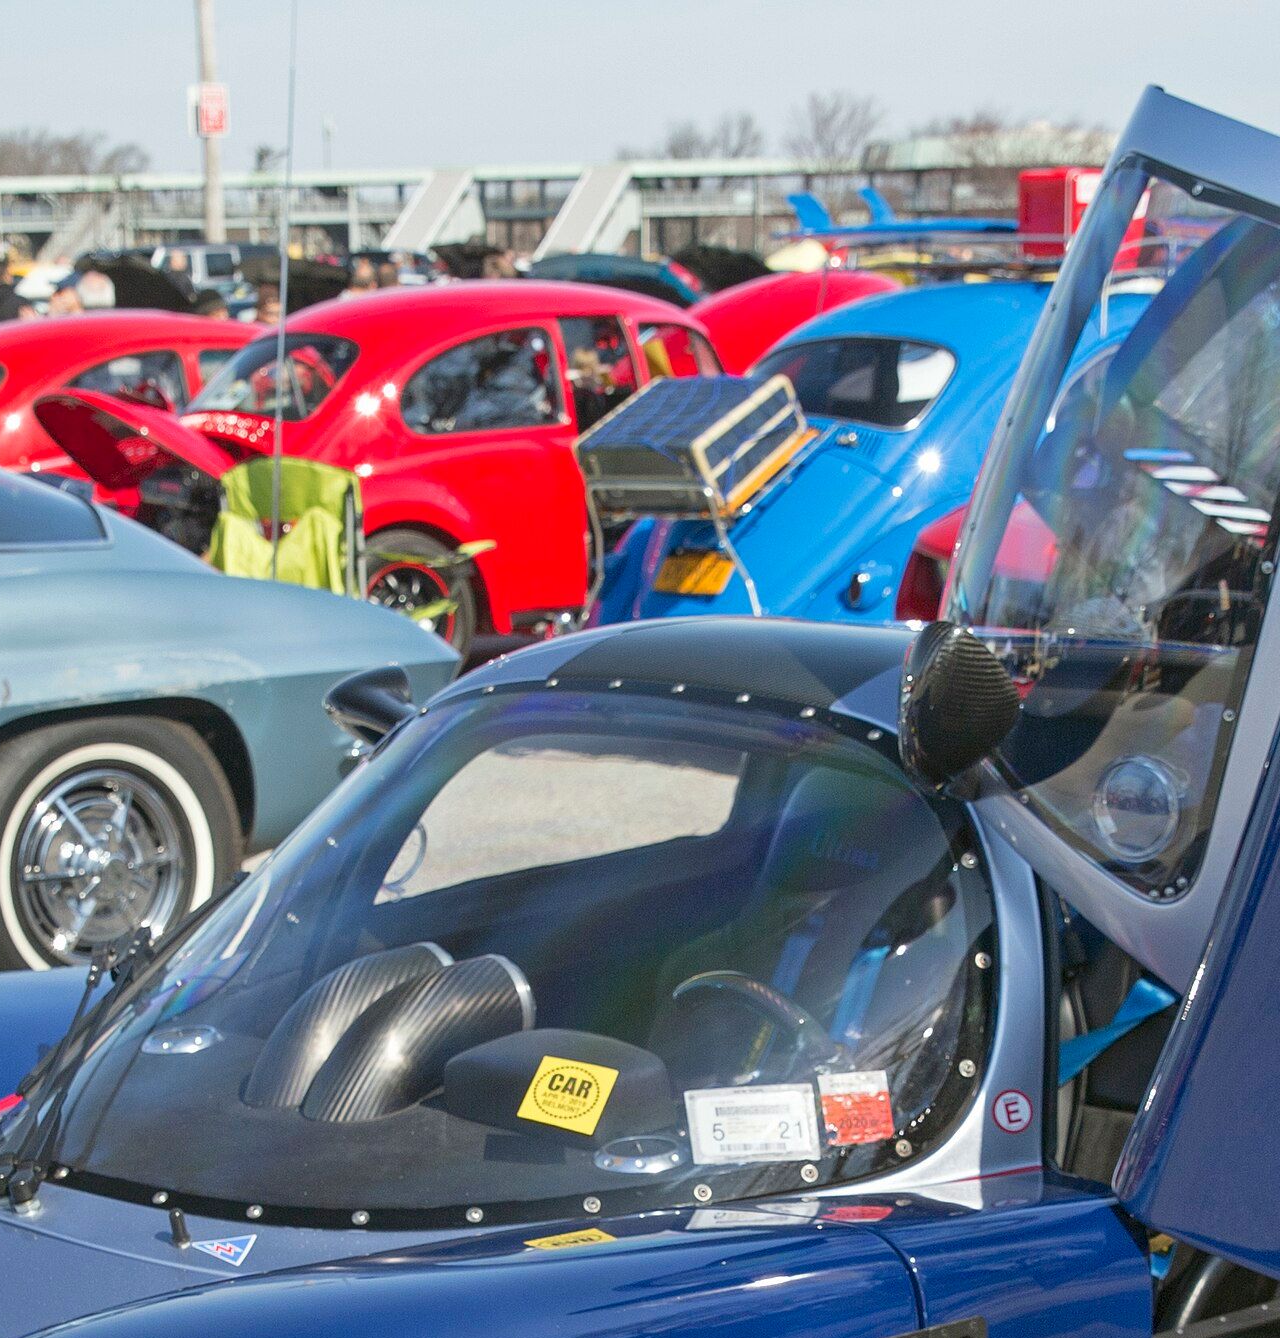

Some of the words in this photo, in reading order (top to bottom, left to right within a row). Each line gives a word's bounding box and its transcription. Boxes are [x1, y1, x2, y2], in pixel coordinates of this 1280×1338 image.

[548, 1073, 593, 1099] CAR
[1005, 1101, 1023, 1124] E
[713, 1122, 725, 1141] 5
[778, 1121, 803, 1139] 21
